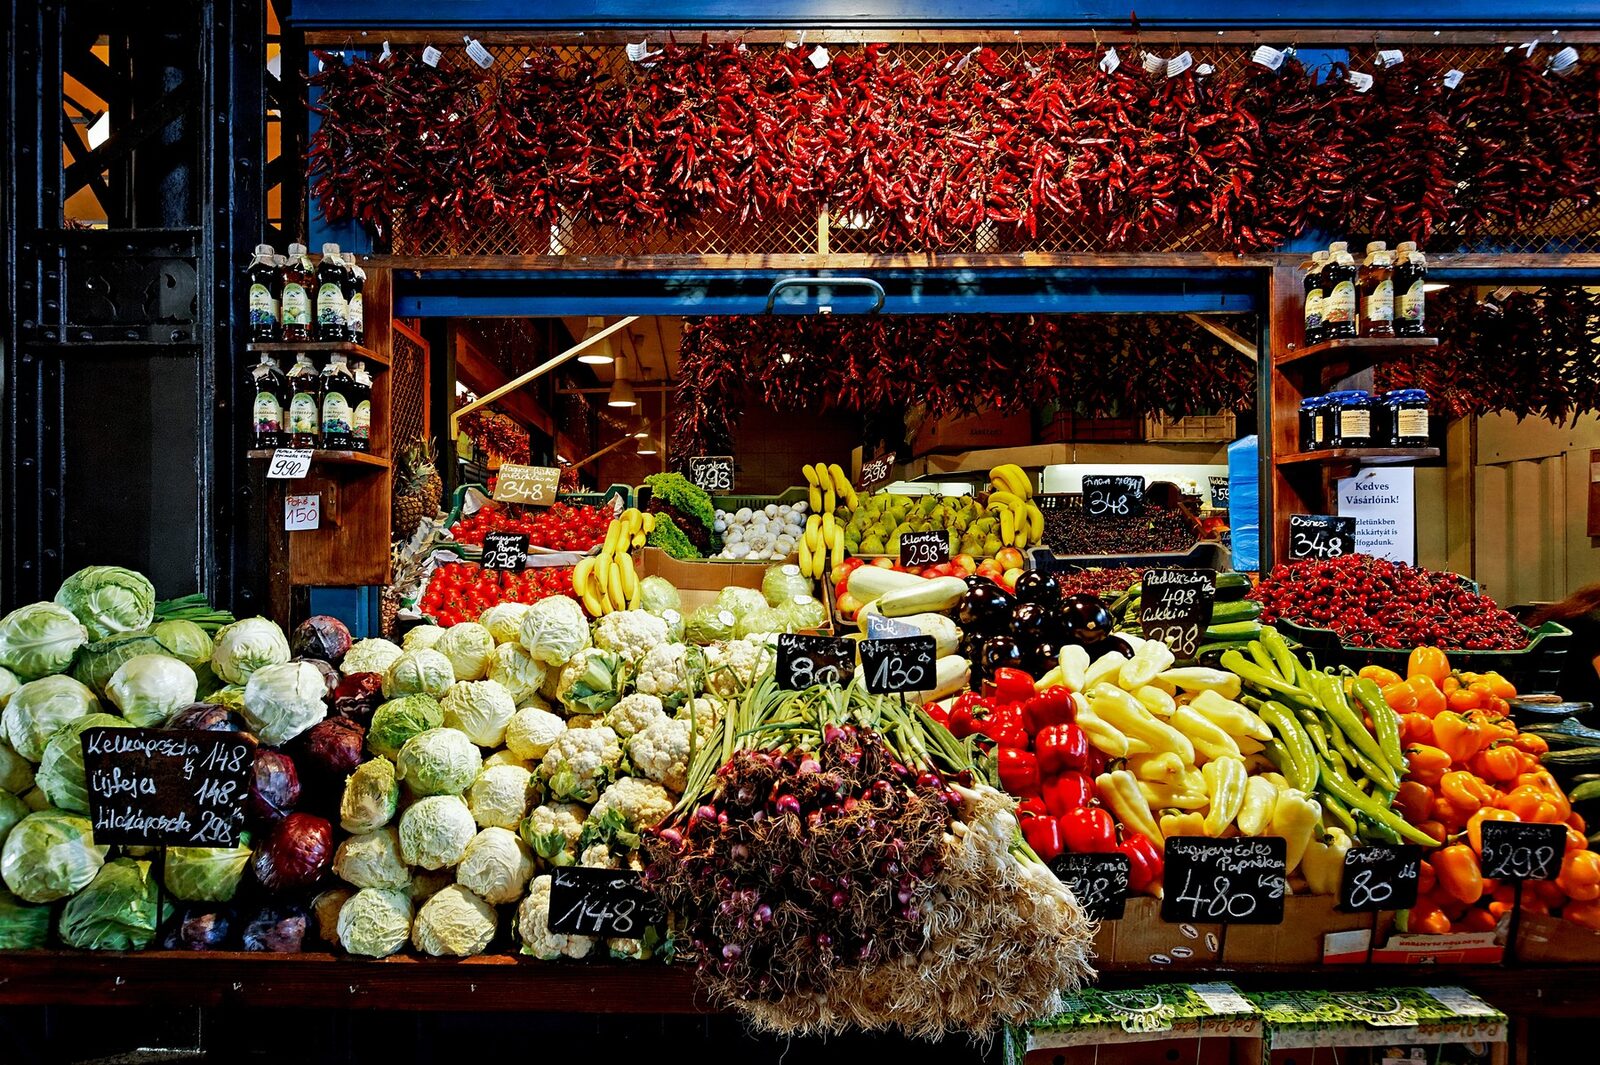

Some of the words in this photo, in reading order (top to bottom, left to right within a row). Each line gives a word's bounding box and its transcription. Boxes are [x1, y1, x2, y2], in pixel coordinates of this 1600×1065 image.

[696, 468, 730, 490] 498
[1355, 482, 1389, 491] Kedves
[499, 481, 543, 501] 348
[1089, 490, 1129, 514] 348
[1346, 495, 1399, 505] Vásárlóink!
[287, 508, 317, 524] 150
[1354, 528, 1390, 537] nkkártyát
[1355, 539, 1394, 547] lfogadunk.
[906, 544, 938, 567] 298
[1294, 532, 1342, 557] 348
[484, 551, 517, 568] 298
[1161, 588, 1197, 607] 498
[1149, 623, 1198, 655] 298
[872, 656, 924, 689] 130
[88, 730, 200, 758] Kelkáposzta
[1489, 843, 1554, 879] 298
[1175, 868, 1257, 918] 480
[1350, 870, 1392, 907] 80
